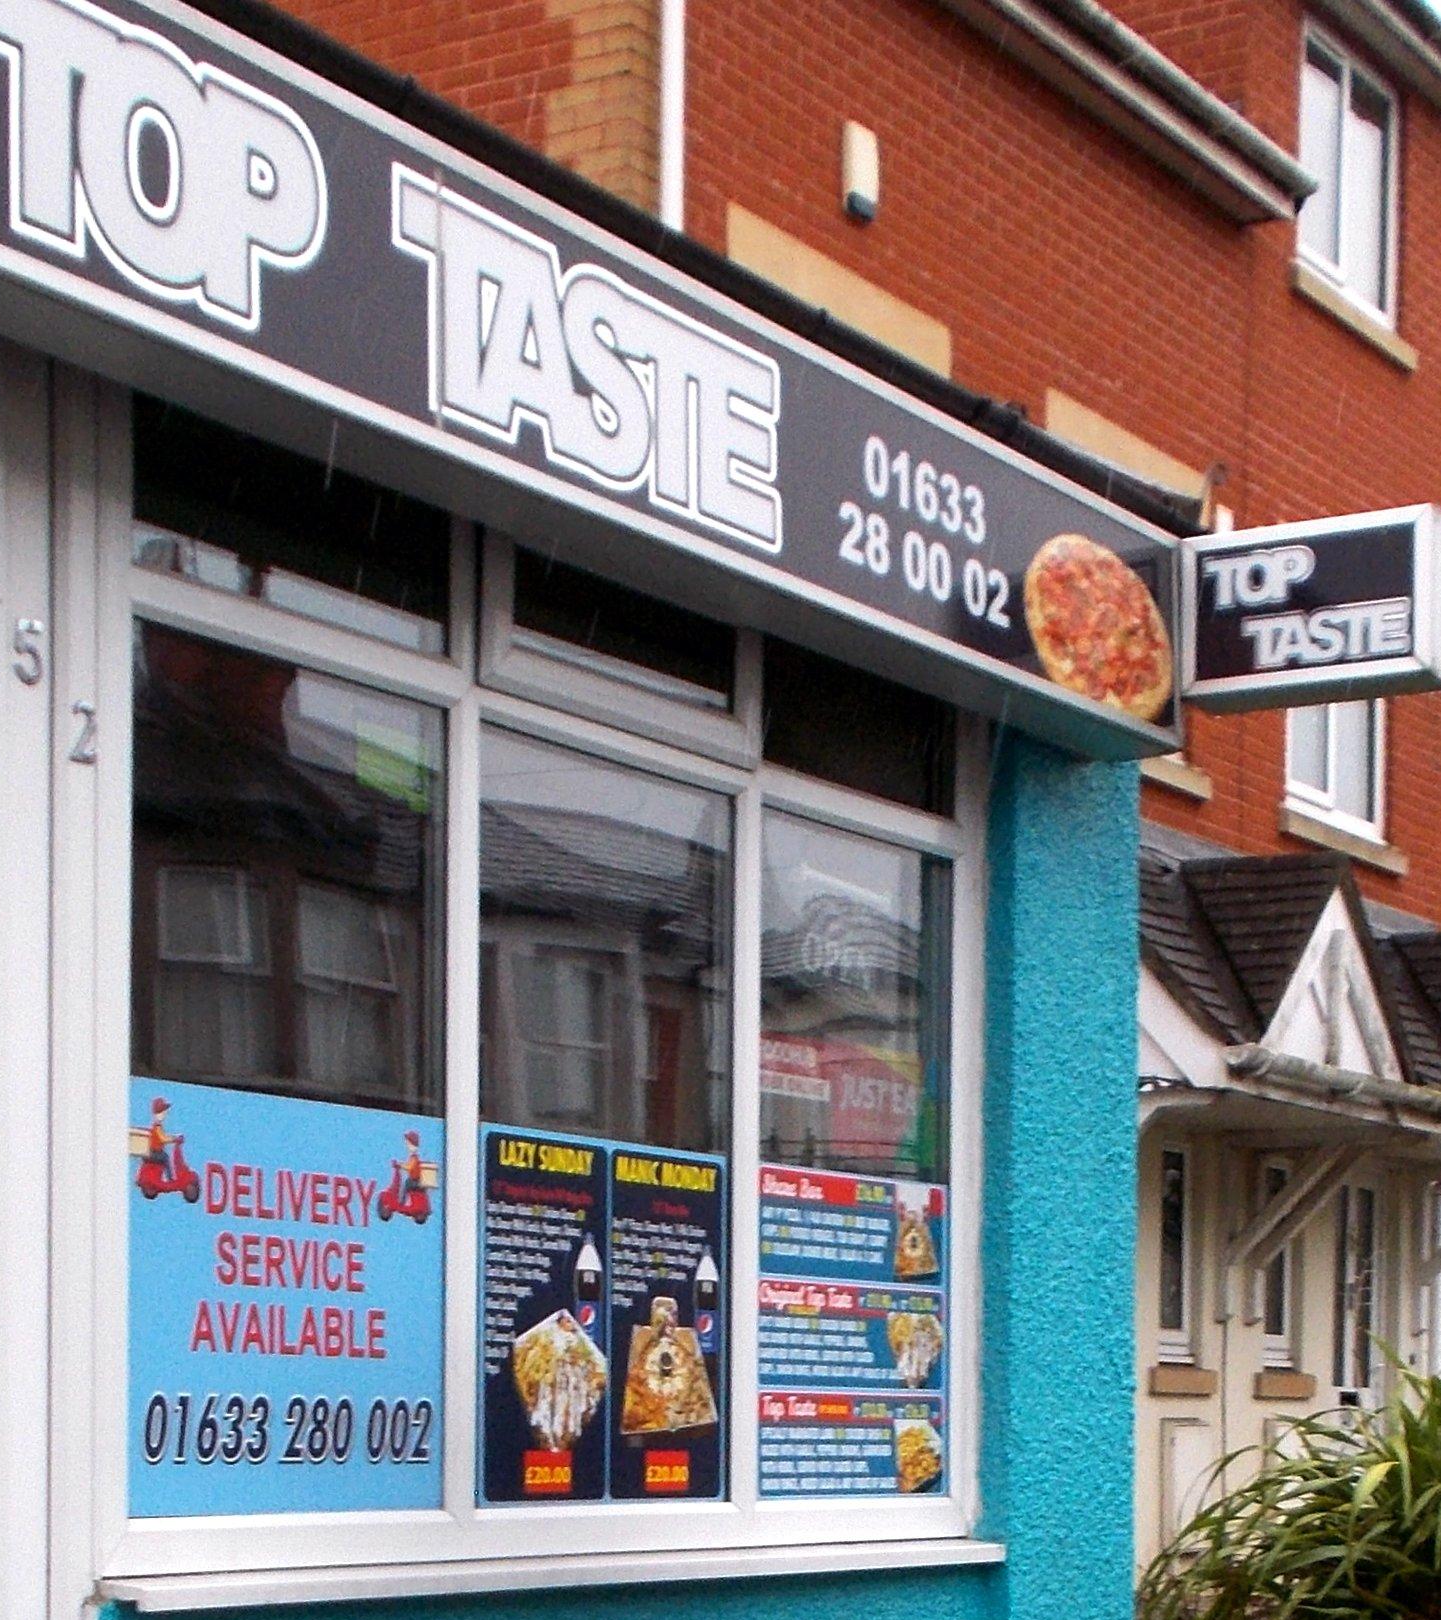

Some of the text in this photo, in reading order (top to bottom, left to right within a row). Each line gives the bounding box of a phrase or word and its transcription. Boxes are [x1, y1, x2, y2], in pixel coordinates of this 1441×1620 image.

[392, 150, 783, 554] TASTE
[863, 433, 988, 545] 01633
[837, 500, 1011, 629] 28 00 02
[1201, 545, 1317, 611] TOP
[1240, 596, 1412, 670] TASTE
[498, 1138, 595, 1177] LAZY SUNDAY
[661, 1161, 718, 1193] MONDAY
[203, 1161, 378, 1228] DELIVERY
[214, 1230, 367, 1293] SERVICE
[189, 1300, 388, 1360] AVAILABLE
[141, 1390, 434, 1466] 01633 280 002
